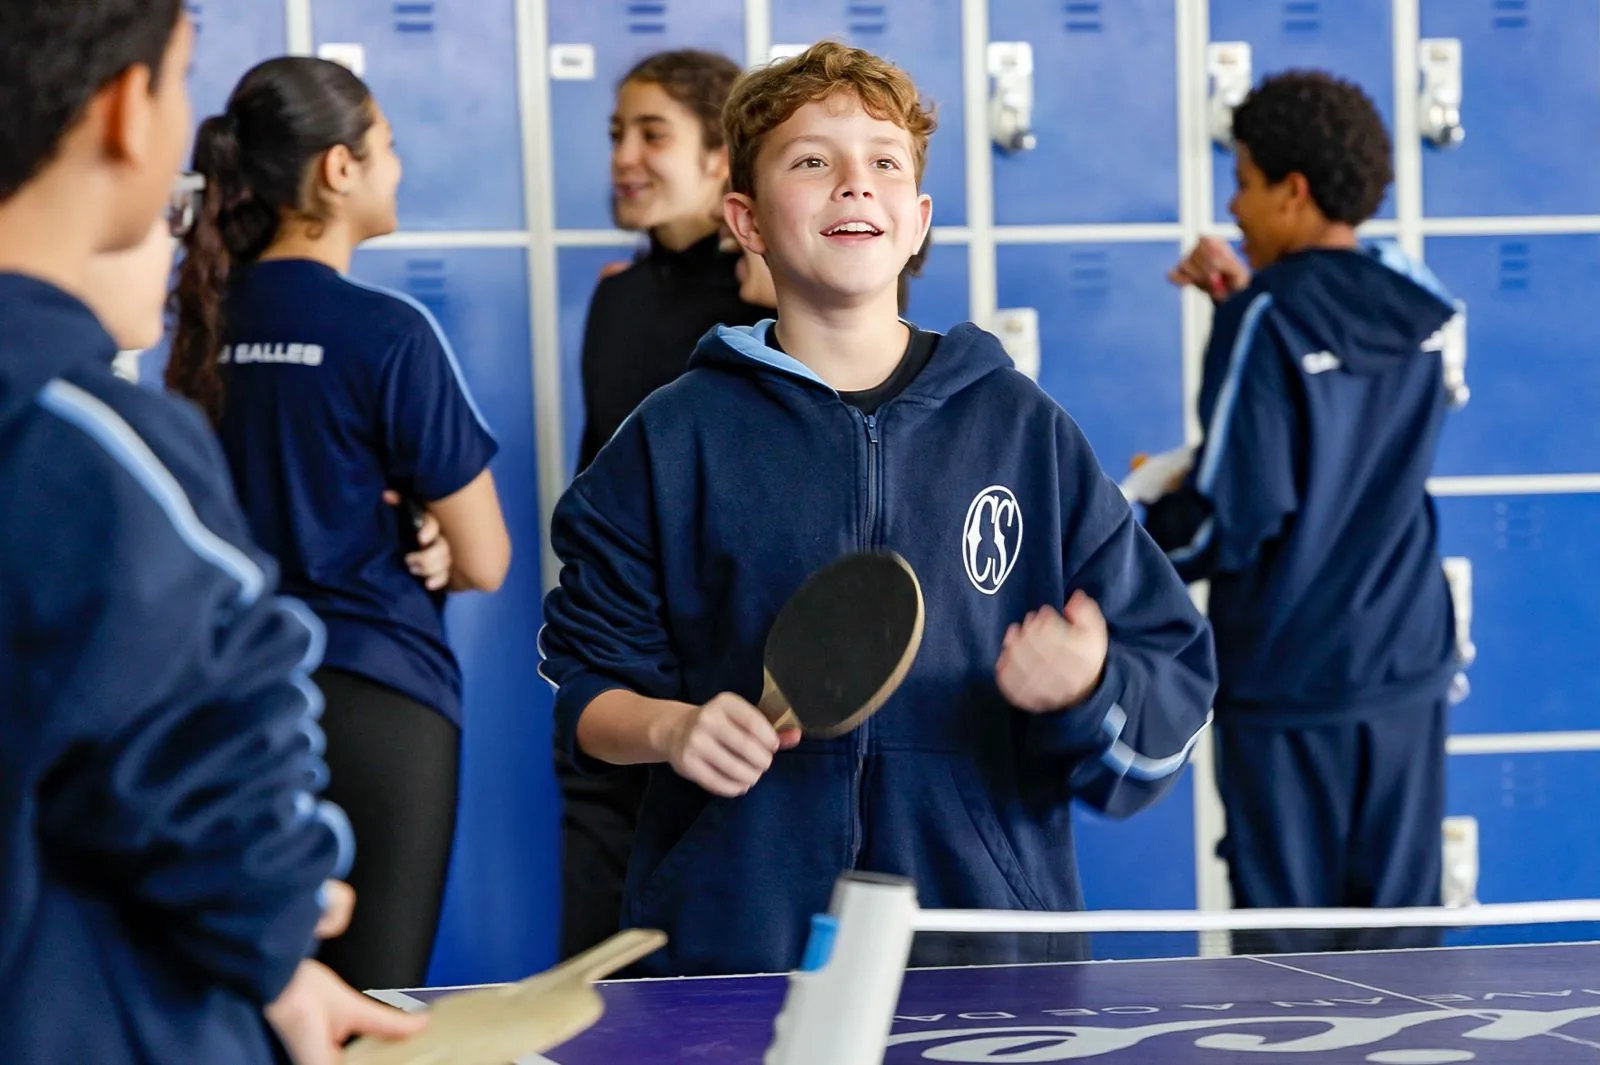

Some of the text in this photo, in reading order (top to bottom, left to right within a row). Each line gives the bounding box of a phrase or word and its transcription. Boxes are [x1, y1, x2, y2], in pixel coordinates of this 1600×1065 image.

[966, 494, 1016, 586] CS
[892, 1012, 1017, 1022] DA
[1271, 997, 1383, 1007] AN
[884, 1006, 1600, 1064] ice
